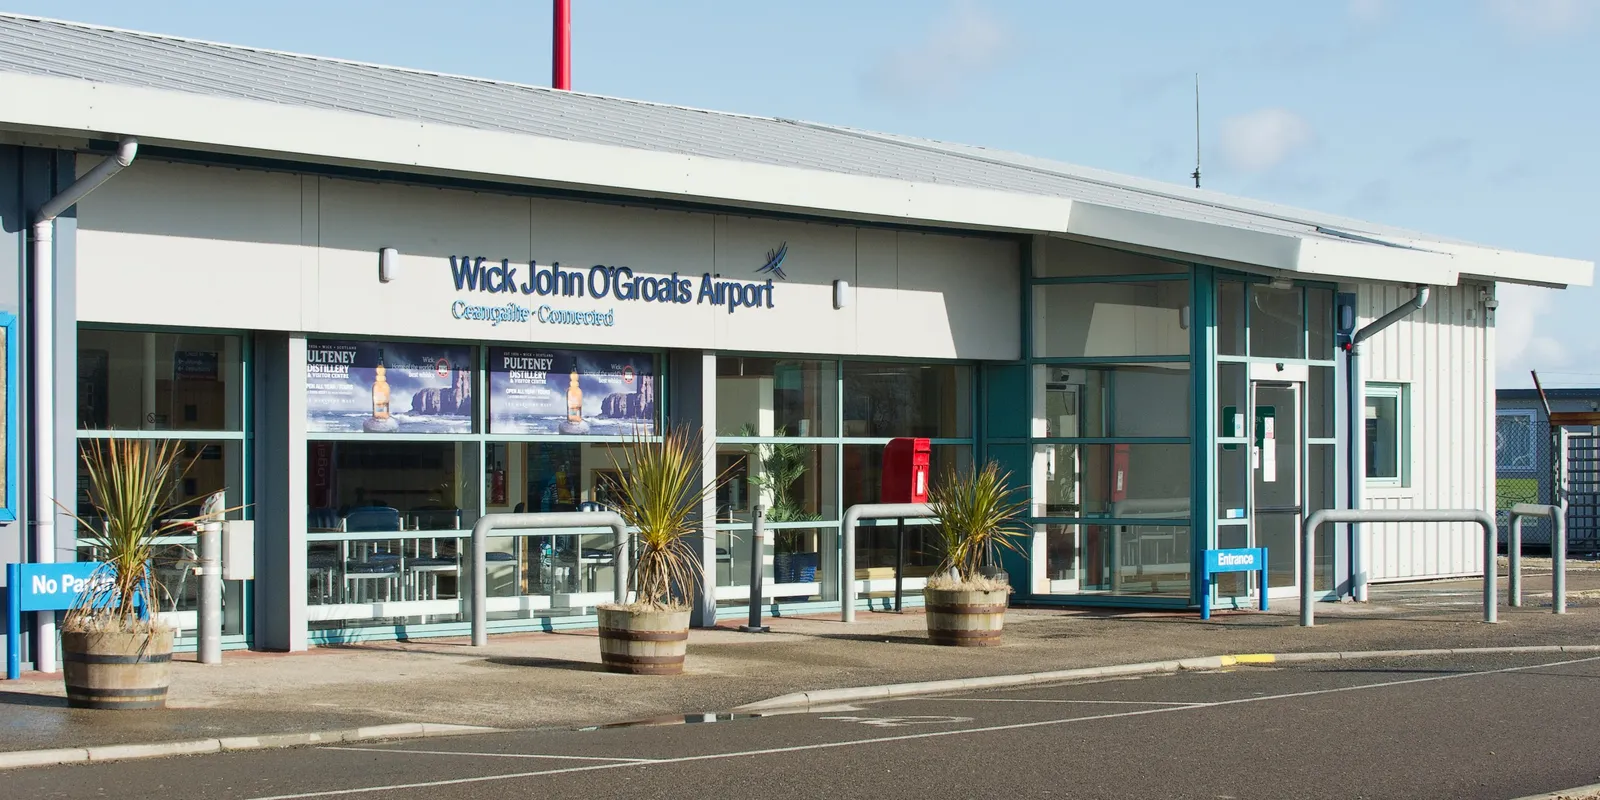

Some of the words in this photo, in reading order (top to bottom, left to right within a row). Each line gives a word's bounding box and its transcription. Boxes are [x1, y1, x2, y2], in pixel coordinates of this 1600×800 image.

[449, 255, 518, 293] Wick
[521, 260, 584, 298] John
[588, 265, 692, 304] O'Groats
[697, 272, 775, 314] Airport
[538, 304, 614, 327] Connected
[307, 350, 356, 364] ULTENEY
[503, 357, 553, 371] PULTENEY
[307, 363, 350, 373] DISTILLERY
[509, 369, 547, 379] DISTILLERY
[1218, 552, 1254, 566] Entrance
[32, 575, 57, 594] No
